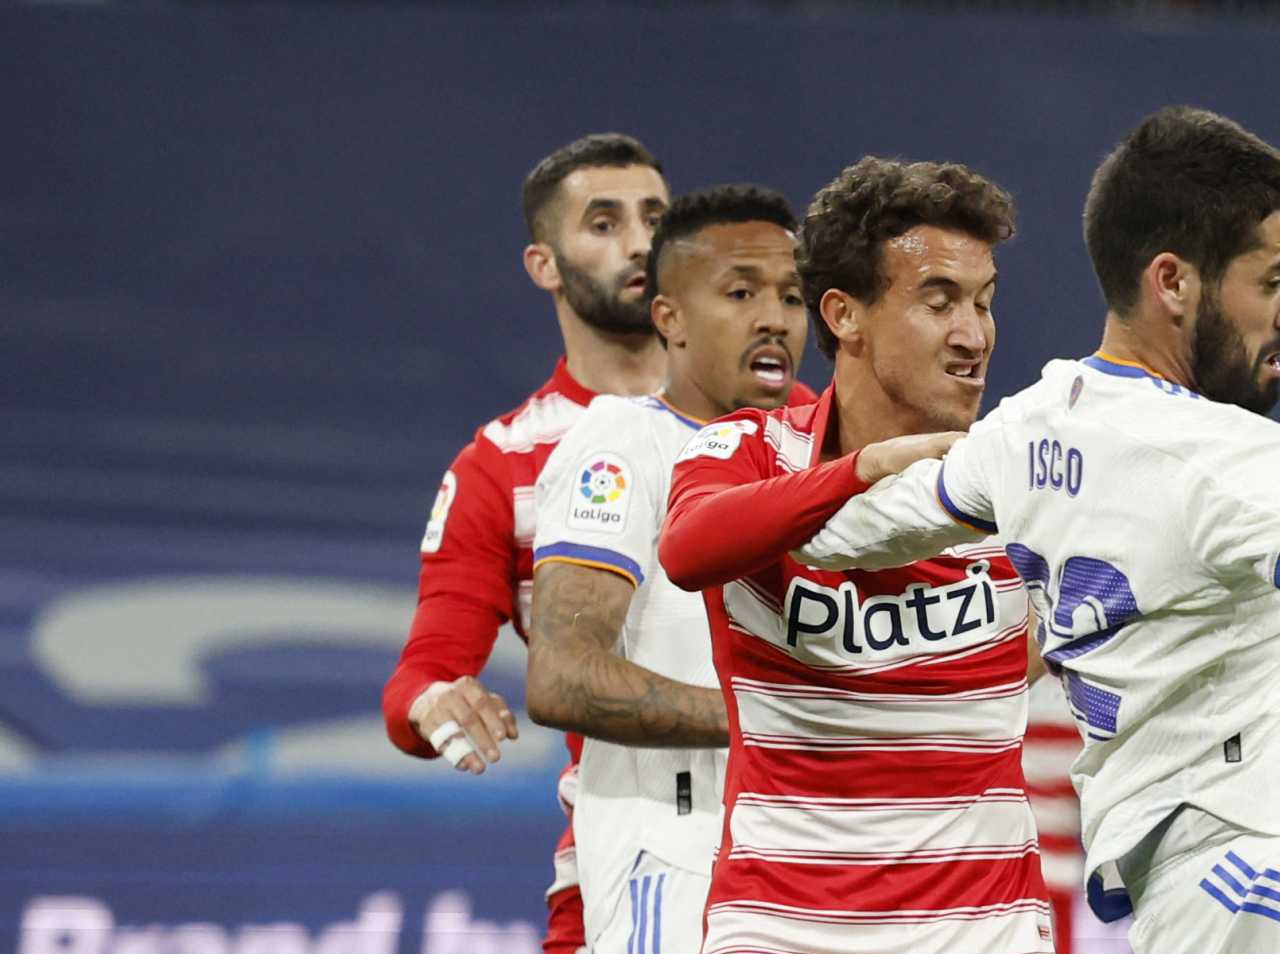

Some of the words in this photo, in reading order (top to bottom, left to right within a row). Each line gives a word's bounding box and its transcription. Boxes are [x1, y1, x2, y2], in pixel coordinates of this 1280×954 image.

[1029, 438, 1084, 498] ISCO
[573, 507, 621, 524] LaLiga
[786, 562, 996, 654] Platzi
